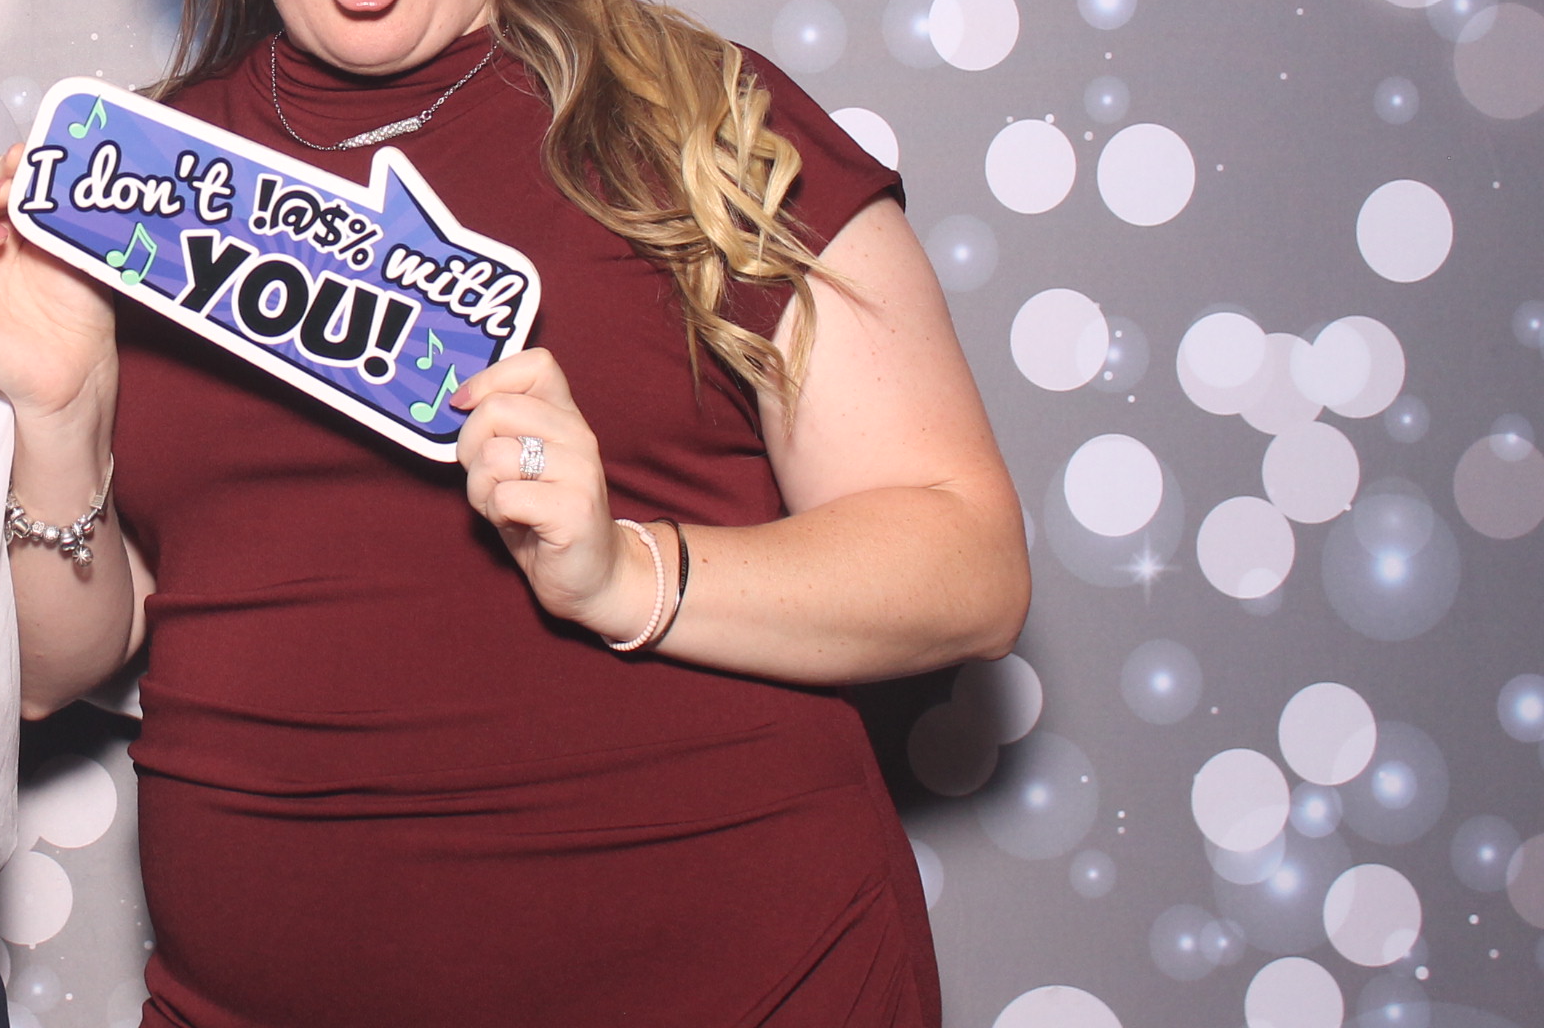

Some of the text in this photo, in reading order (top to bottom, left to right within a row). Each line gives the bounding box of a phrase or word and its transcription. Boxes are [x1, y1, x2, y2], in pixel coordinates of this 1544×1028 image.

[22, 142, 527, 337] I don't !@$% with
[183, 234, 420, 379] YOU!
